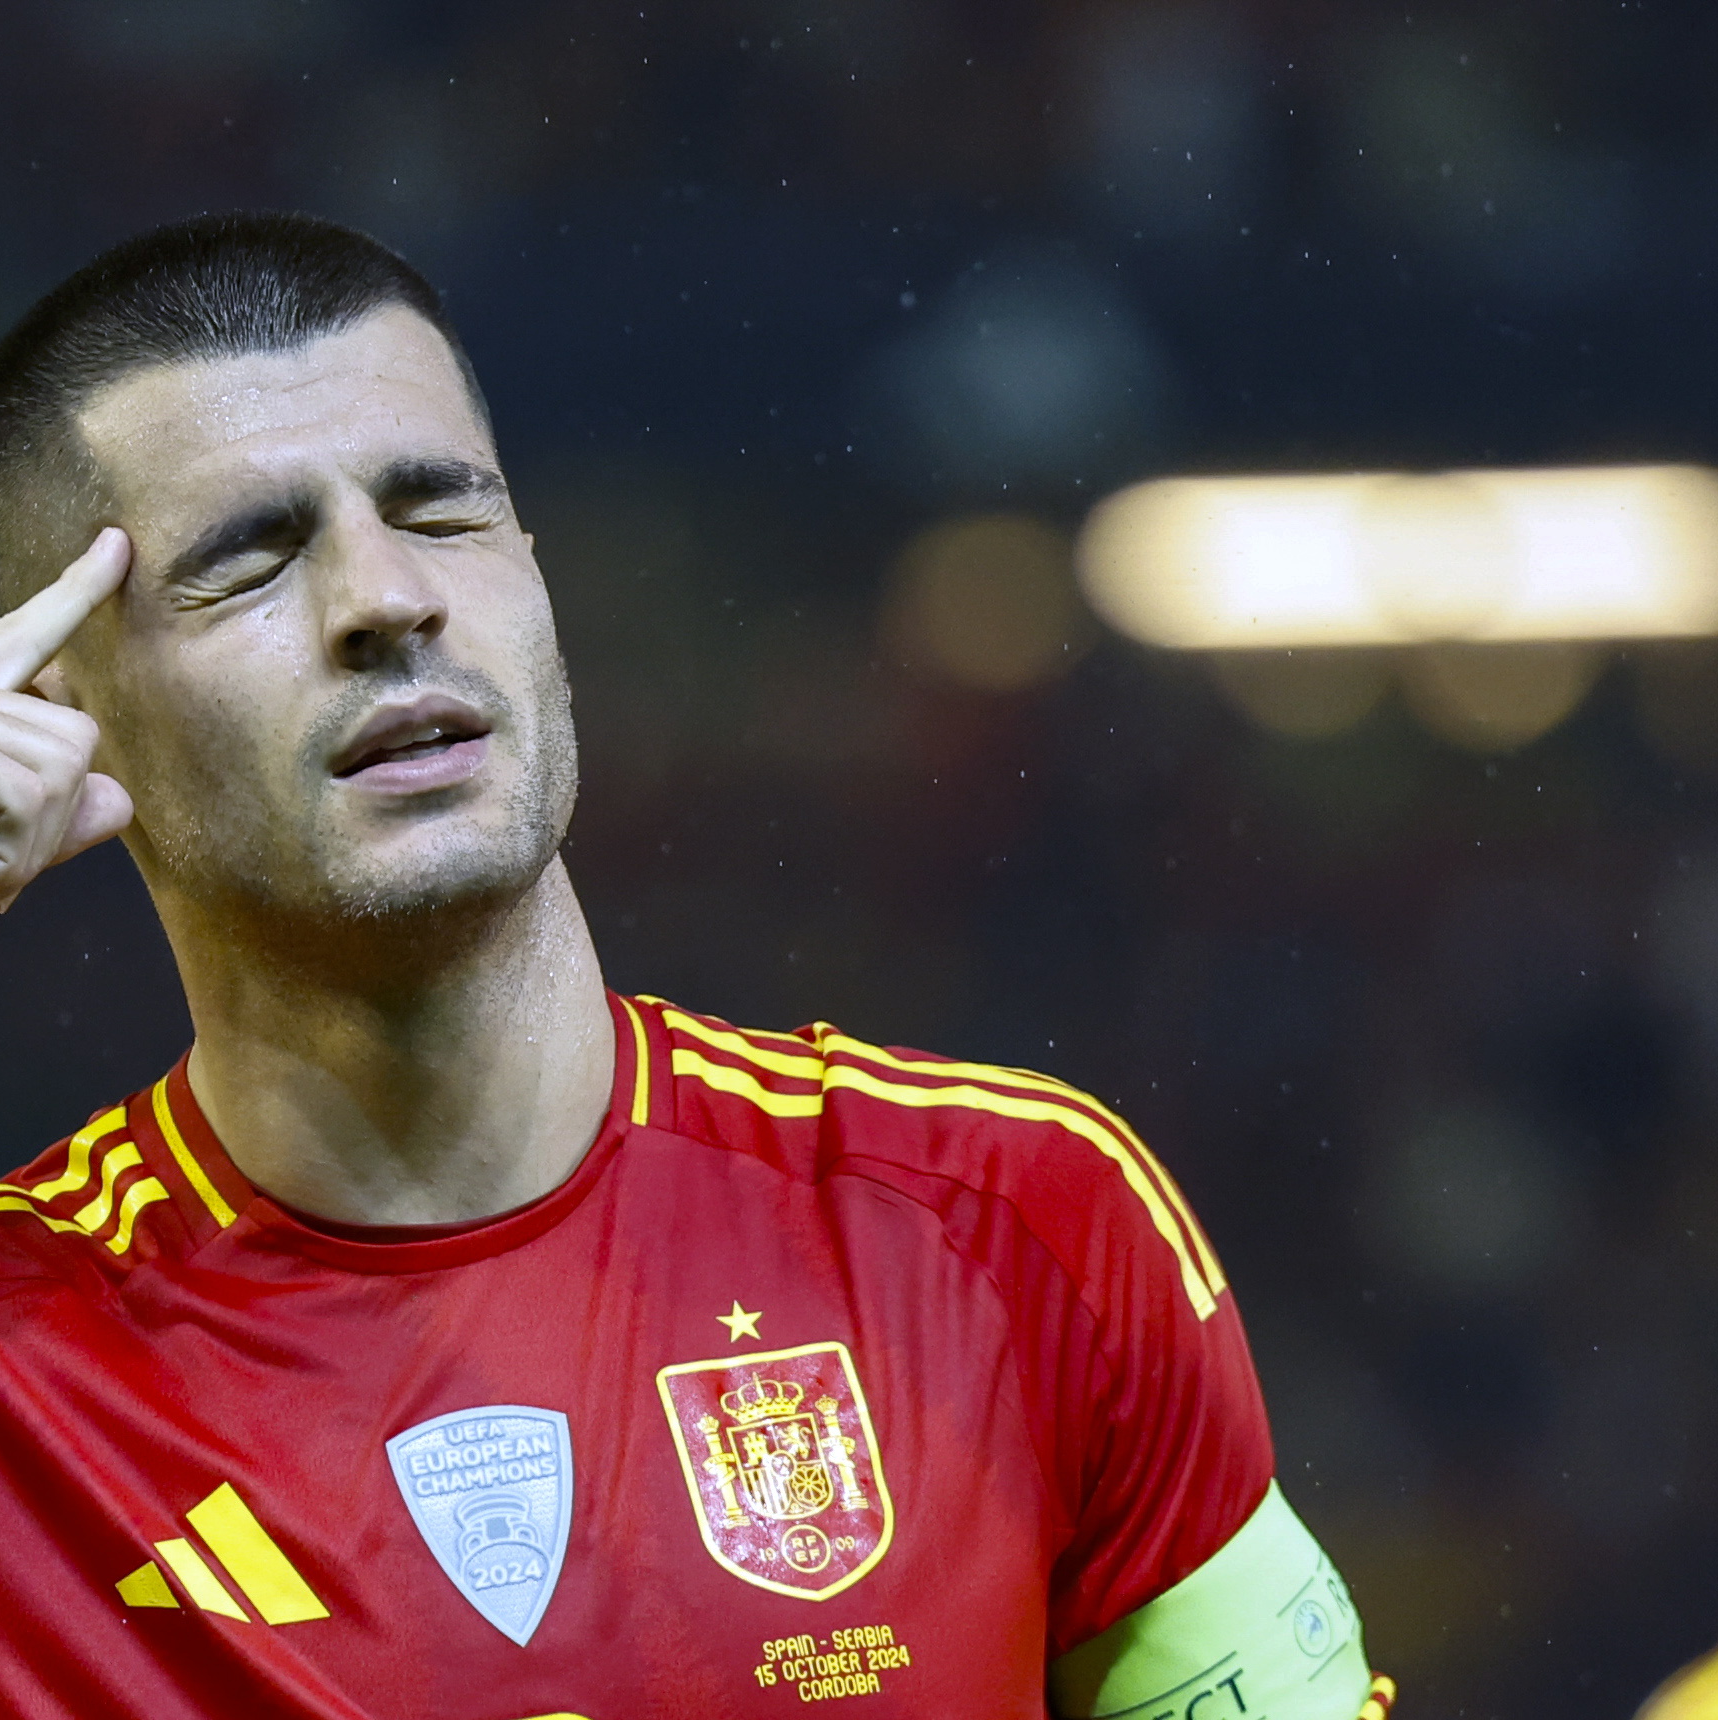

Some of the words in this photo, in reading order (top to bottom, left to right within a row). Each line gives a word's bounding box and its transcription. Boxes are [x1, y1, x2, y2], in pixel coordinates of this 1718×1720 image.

[447, 1422, 504, 1445] UEFA
[410, 1435, 552, 1476] EUROPEAN
[414, 1458, 556, 1496] CHAMPIONS
[759, 1547, 776, 1561] 19
[792, 1535, 817, 1548] RF
[795, 1548, 820, 1562] EF
[835, 1536, 855, 1551] 09
[472, 1559, 543, 1590] 2024
[763, 1634, 817, 1661] SPAIN
[832, 1625, 894, 1650] SERBIA
[754, 1664, 777, 1687] 15
[782, 1652, 862, 1681] OCTOBER
[867, 1645, 910, 1670] 2024
[798, 1673, 880, 1702] CORDOBA
